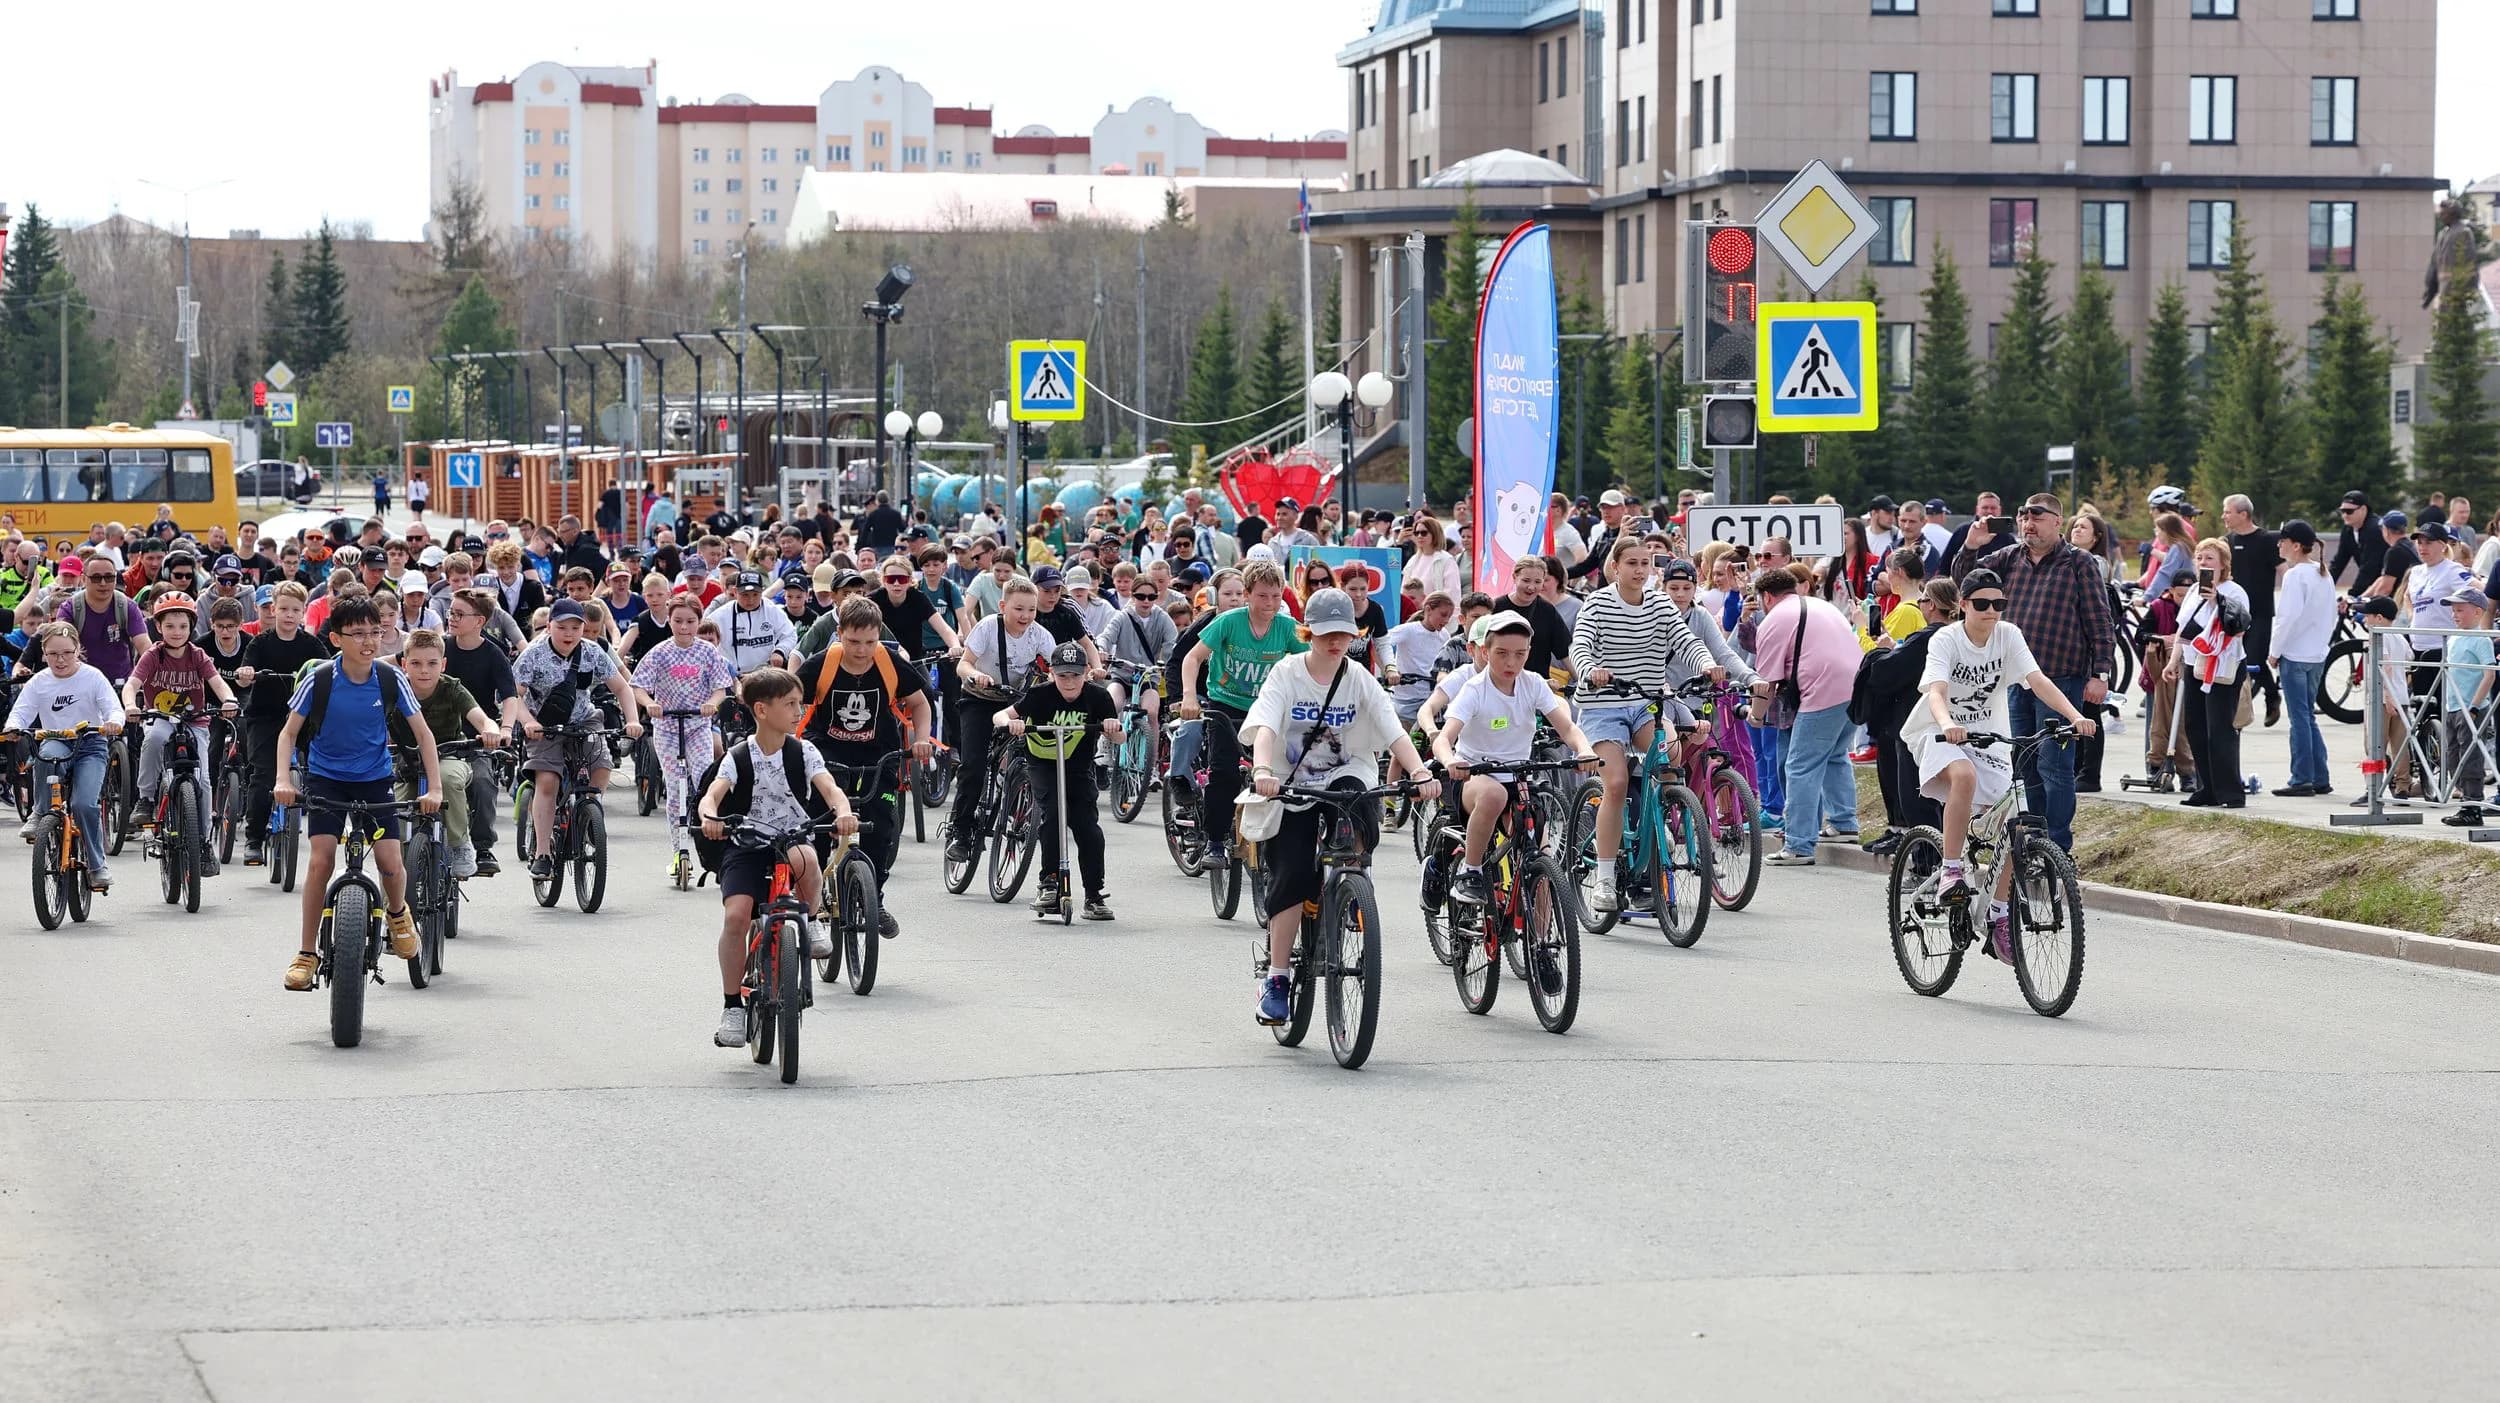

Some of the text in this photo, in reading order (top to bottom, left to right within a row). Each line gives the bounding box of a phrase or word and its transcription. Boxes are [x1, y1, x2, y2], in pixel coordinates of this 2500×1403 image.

[9, 508, 47, 526] ЕТИ
[1712, 514, 1822, 546] СТОП
[736, 635, 774, 647] MPRESSED
[1225, 654, 1272, 683] DYNA
[55, 695, 74, 705] NIKE
[1053, 710, 1088, 726] MAKE
[1291, 707, 1356, 726] SORRY
